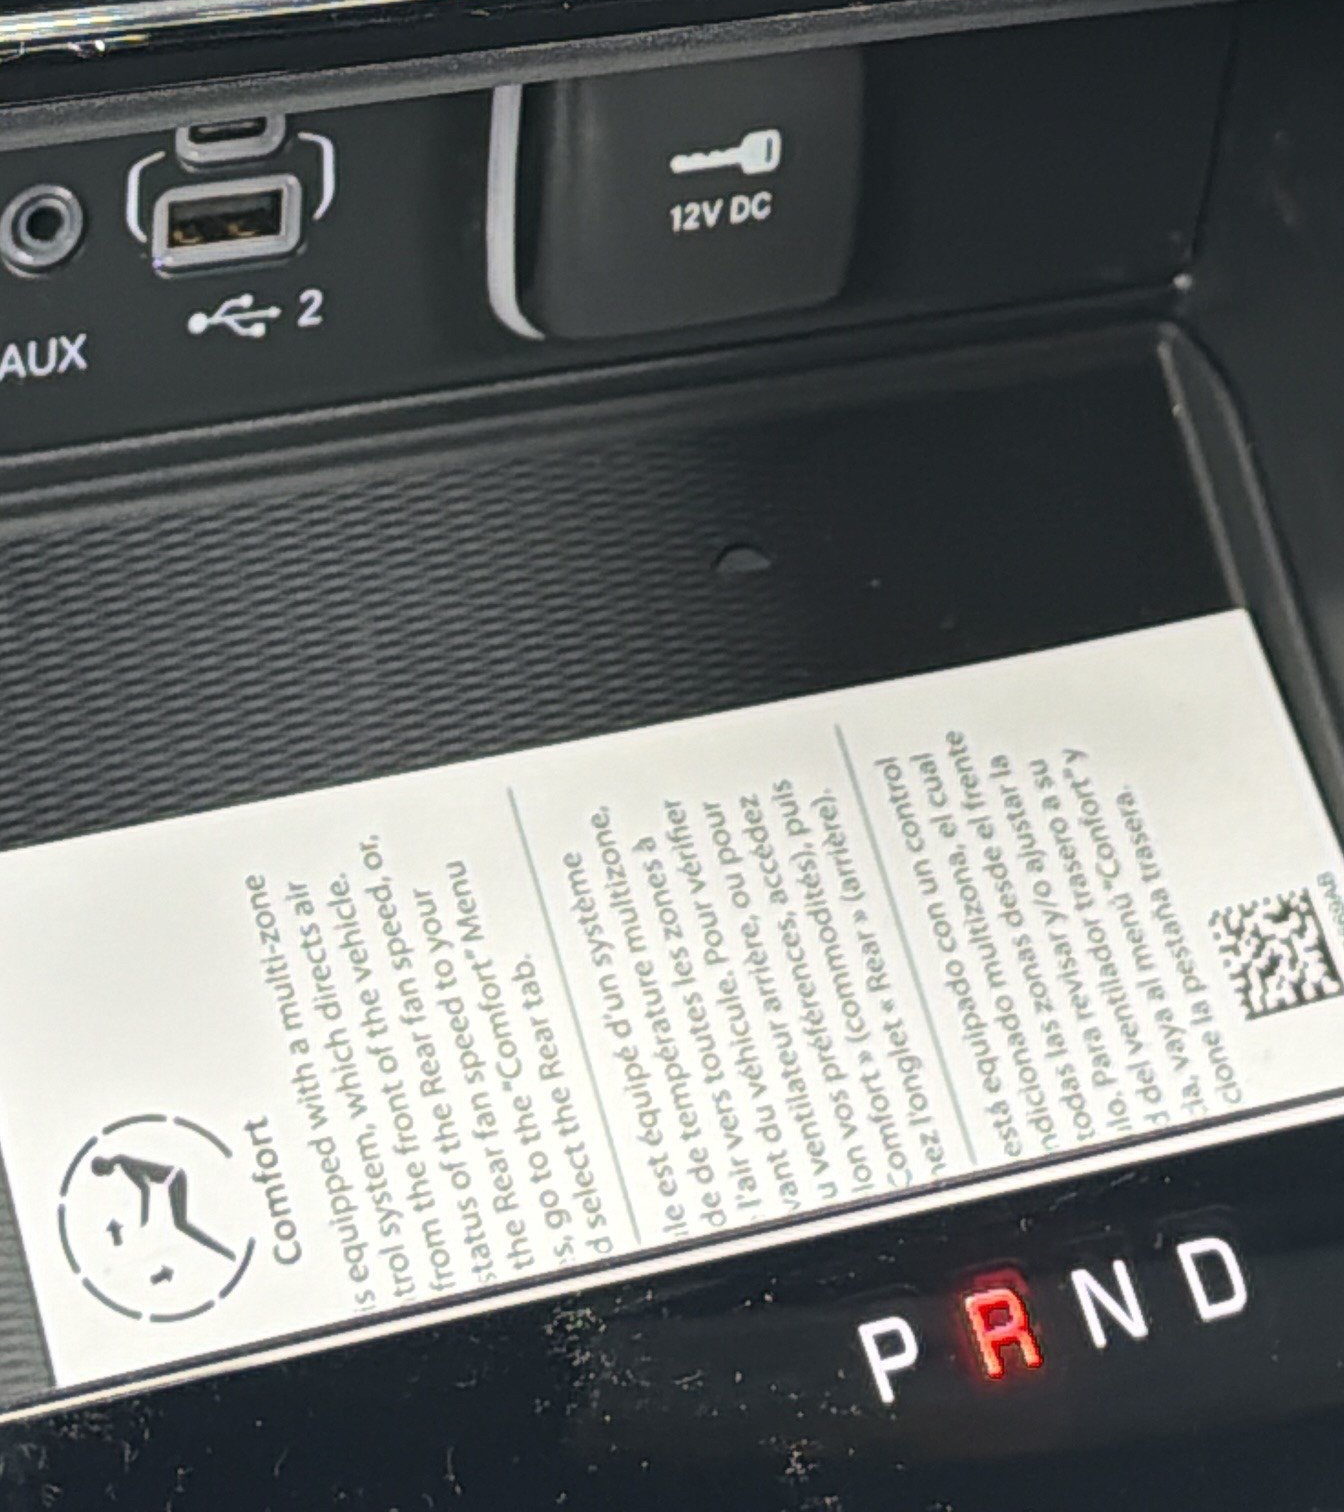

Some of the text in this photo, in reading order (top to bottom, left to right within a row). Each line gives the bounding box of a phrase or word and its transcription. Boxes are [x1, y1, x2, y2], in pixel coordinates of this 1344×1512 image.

[669, 190, 774, 234] 12V DC
[297, 288, 324, 328] 2
[910, 754, 948, 808] cual
[990, 756, 1011, 778] la
[1030, 760, 1054, 790] su
[1063, 750, 1088, 764] y
[772, 780, 811, 836] puis
[929, 814, 958, 838] el
[1000, 785, 1047, 872] ajustar
[1042, 796, 1061, 811] a
[632, 837, 656, 852] à
[665, 801, 706, 894] vérifier
[703, 803, 743, 865] pour
[740, 794, 788, 904] accédez
[725, 873, 751, 908] ou
[1050, 817, 1095, 912] trasero
[285, 882, 314, 915] air
[447, 862, 484, 941] Menu
[564, 853, 613, 966] système
[644, 860, 683, 940] zones
[1033, 880, 1068, 926] y/o
[246, 876, 303, 1030] multi-zone
[694, 902, 729, 966] Pour
[857, 931, 890, 992] Rear
[874, 757, 1022, 1156] está equipado con un control
[947, 732, 1094, 1140] todas las zonas desde el frente
[1108, 893, 1156, 972] menú
[1151, 888, 1208, 994] pestaña
[301, 924, 341, 1020] directs
[670, 947, 696, 987] les
[1049, 933, 1095, 1021] revisar
[1082, 919, 1144, 1055] ventilador
[1137, 978, 1166, 1001] al
[360, 990, 387, 1038] the
[399, 978, 426, 1025] fan
[1191, 1000, 1213, 1025] la
[290, 1039, 309, 1054] a
[367, 1046, 398, 1074] of
[413, 1033, 445, 1096] Rear
[531, 1018, 564, 1080] Rear
[635, 961, 701, 1141] température
[684, 993, 724, 1084] toutes
[1083, 1027, 1117, 1088] Para
[1155, 1008, 1190, 1072] vaya
[291, 1063, 328, 1130] with
[324, 1028, 367, 1119] which
[414, 889, 534, 1269] the Rear fan speed to your
[613, 1046, 662, 1146] équipé
[769, 1021, 829, 1176] ventilateur
[1126, 1061, 1162, 1103] del
[382, 1081, 419, 1154] front
[433, 1104, 460, 1154] the
[514, 1096, 540, 1145] the
[552, 1088, 579, 1136] the
[713, 1090, 742, 1150] vers
[755, 1105, 781, 1143] du
[830, 1090, 857, 1139] vos
[244, 1116, 301, 1265] Comfort
[407, 1162, 434, 1212] the
[439, 1162, 470, 1189] of
[529, 1152, 551, 1183] to
[565, 1142, 606, 1229] select
[648, 1153, 677, 1196] est
[687, 1148, 713, 1184] de
[308, 1137, 368, 1282] equipped
[540, 1190, 571, 1229] go
[700, 1192, 726, 1226] de
[379, 1245, 415, 1300] trol
[423, 1219, 455, 1291] from
[857, 1236, 1249, 1405] P R N D
